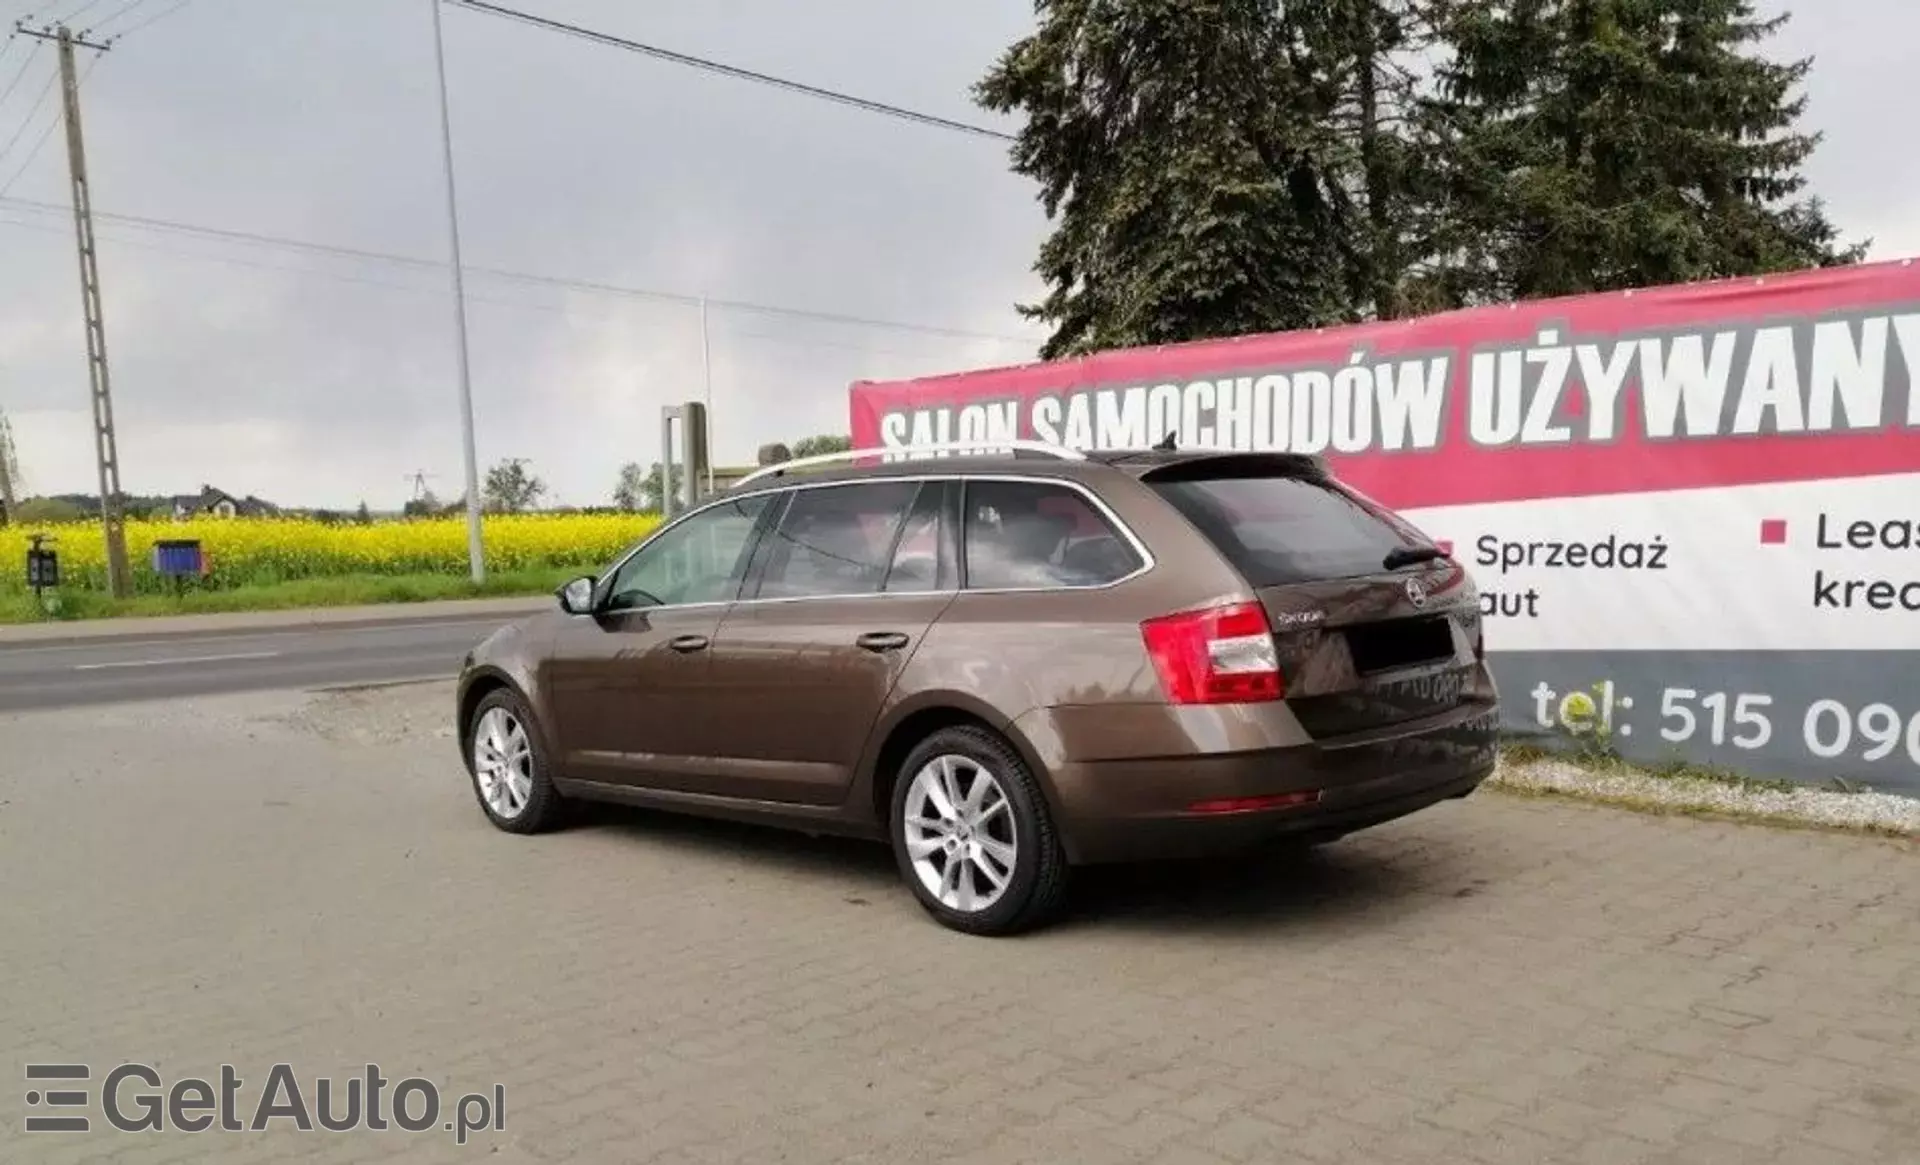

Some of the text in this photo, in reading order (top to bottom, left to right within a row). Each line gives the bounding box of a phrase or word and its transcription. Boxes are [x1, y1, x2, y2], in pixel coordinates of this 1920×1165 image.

[880, 401, 1018, 464] SALON
[1032, 350, 1448, 454] SAMOCHODÓW
[1817, 512, 1920, 549] Lea
[1476, 534, 1669, 573] Sprzedaż
[1479, 588, 1539, 617] aut
[1530, 680, 1634, 736] tel:
[1659, 687, 1774, 750] 515
